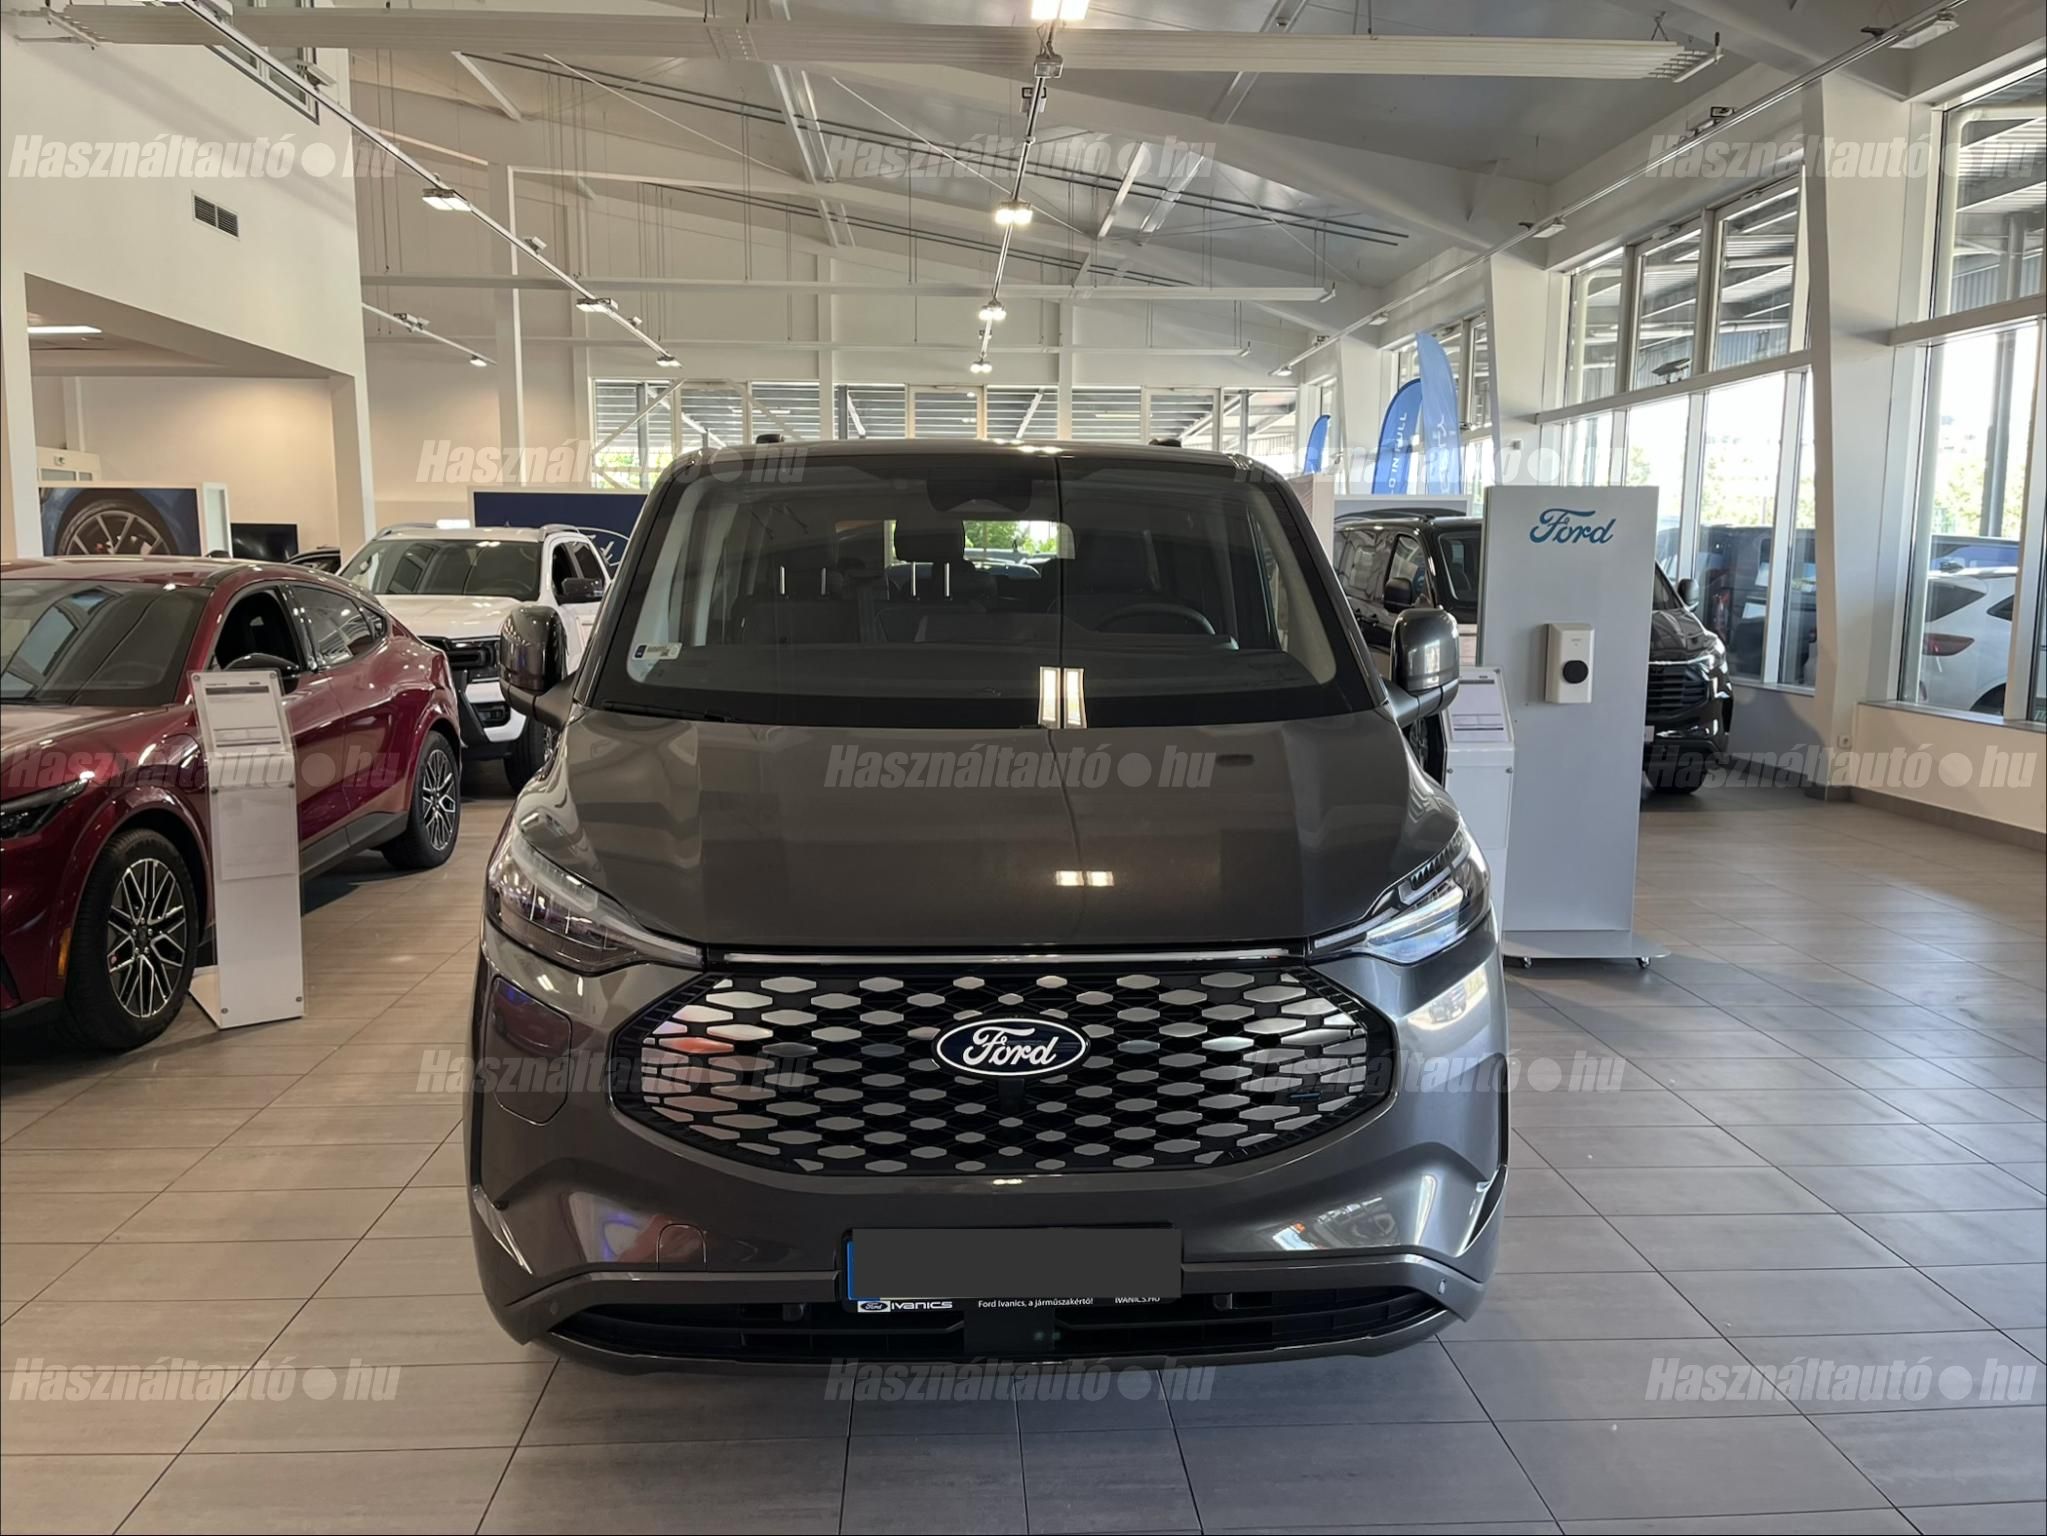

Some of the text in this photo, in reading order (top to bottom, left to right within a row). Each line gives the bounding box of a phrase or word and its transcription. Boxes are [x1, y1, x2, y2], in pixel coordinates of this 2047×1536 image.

[1530, 508, 1616, 544] Ford
[963, 1026, 1059, 1066] Ford
[978, 1300, 996, 1308] Ford
